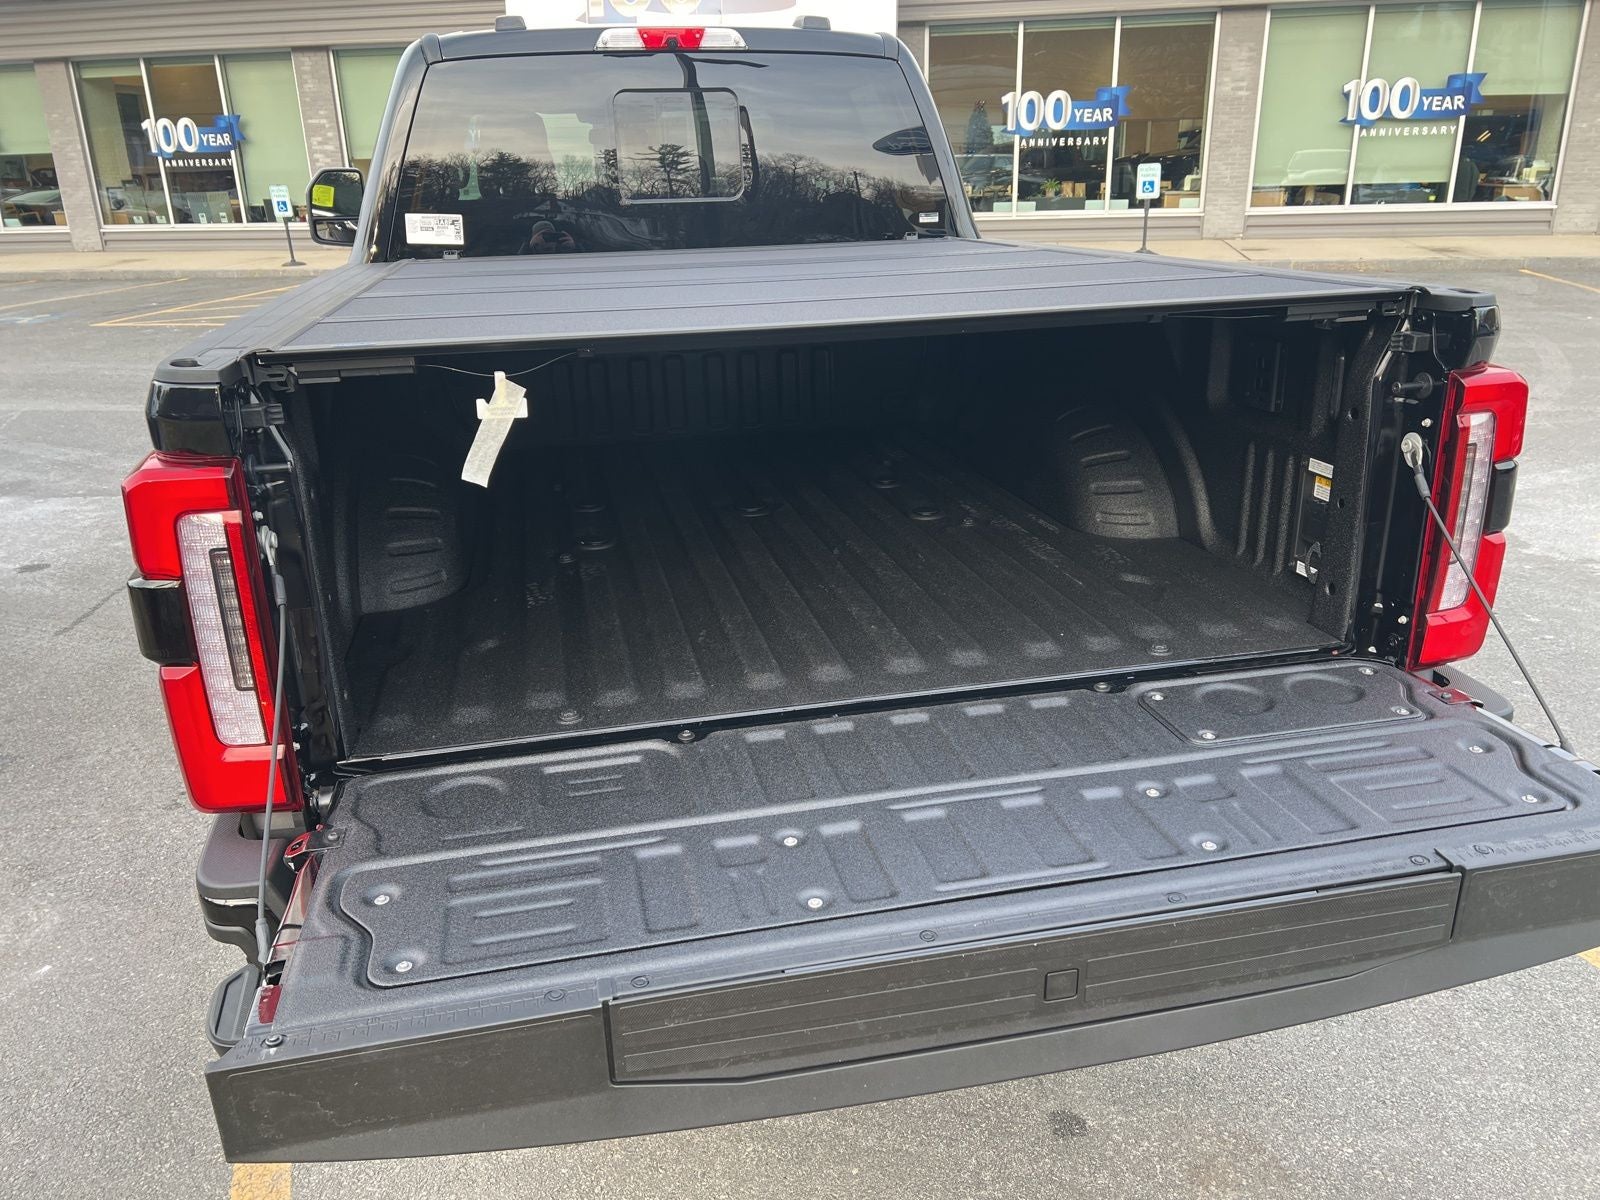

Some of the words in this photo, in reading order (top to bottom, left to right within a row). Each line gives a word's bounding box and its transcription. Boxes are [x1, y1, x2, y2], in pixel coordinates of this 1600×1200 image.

[1001, 90, 1072, 131] 100
[1073, 108, 1113, 122] YEAR
[1343, 77, 1420, 120] 100
[1422, 95, 1465, 111] YEAR
[141, 117, 199, 153] 100
[200, 133, 232, 147] YEAR
[1020, 136, 1108, 147] ANNIVERSARY
[1360, 125, 1457, 137] ANNIVERSARY
[165, 158, 232, 167] ANNIVERSARY
